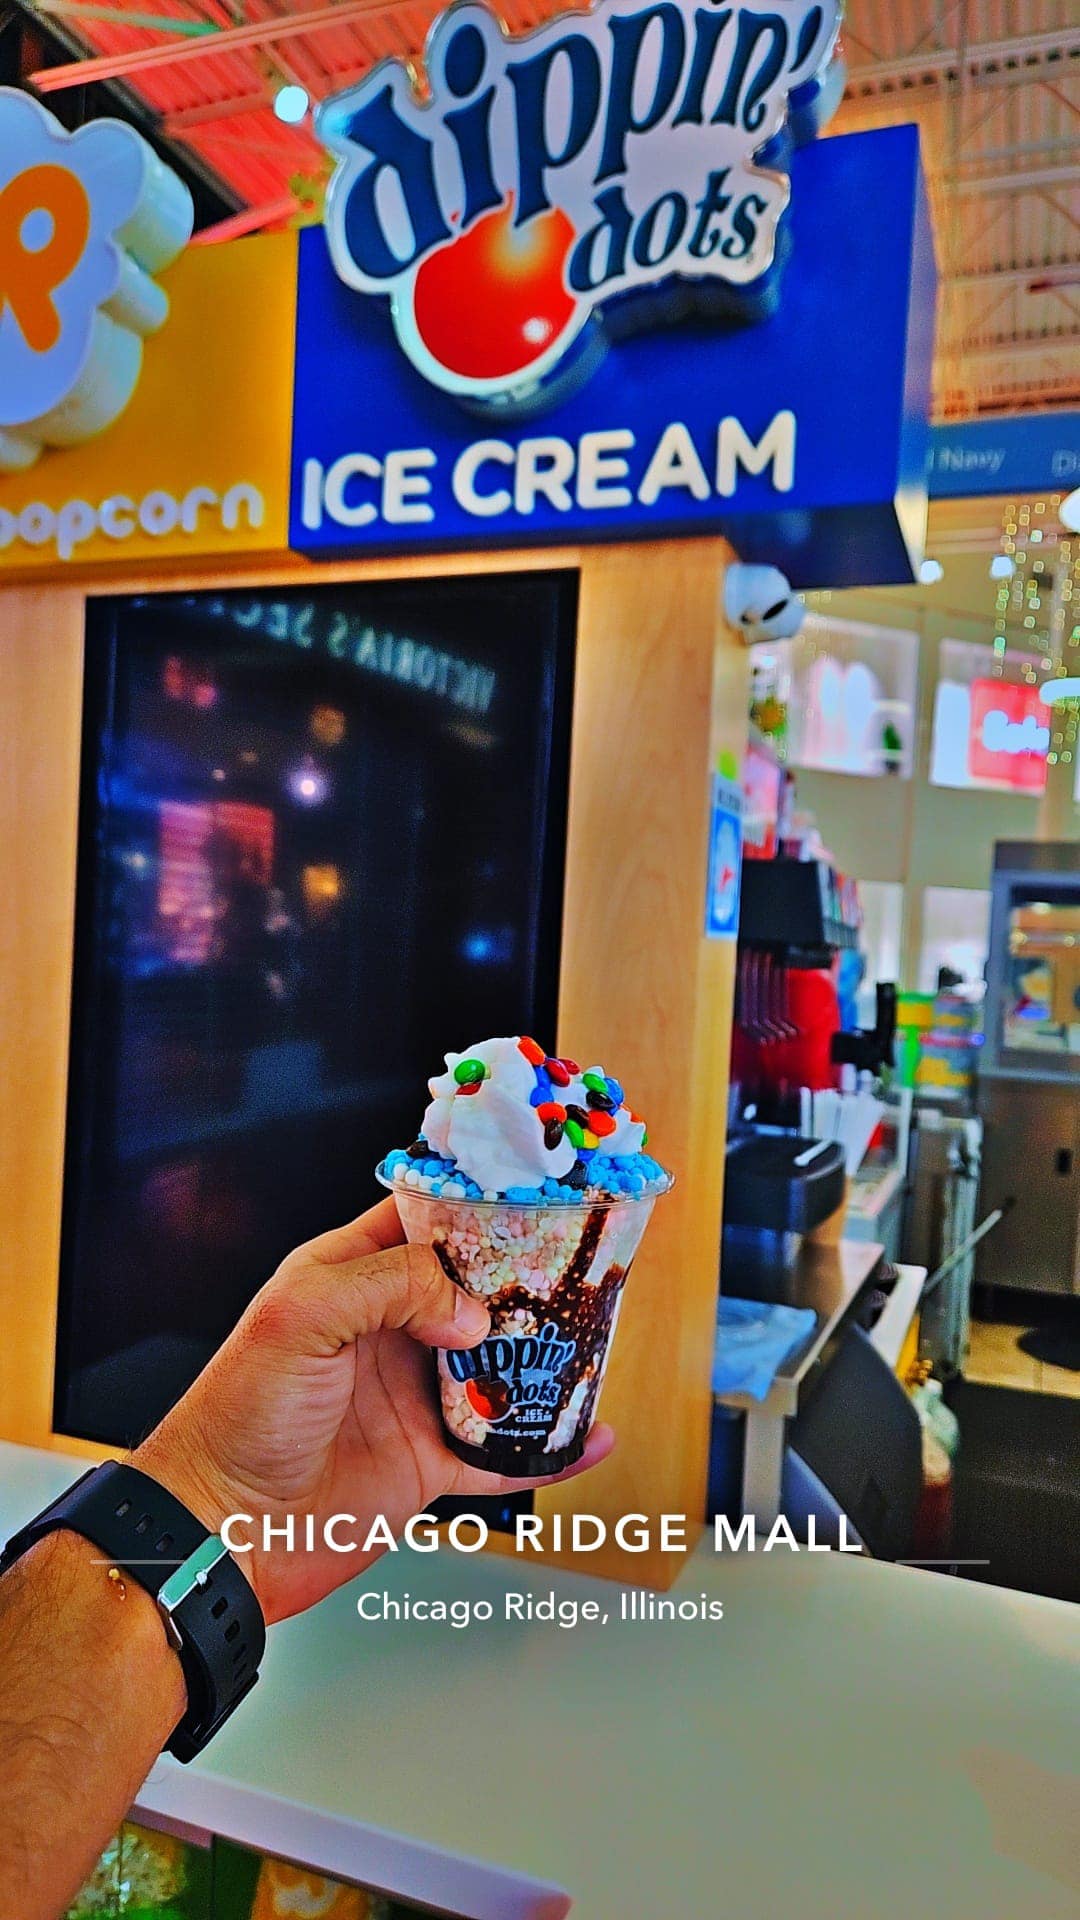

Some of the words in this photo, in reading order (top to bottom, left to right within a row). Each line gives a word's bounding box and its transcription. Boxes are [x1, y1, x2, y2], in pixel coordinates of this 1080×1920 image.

[345, 0, 822, 279] dippin'
[568, 169, 768, 293] dots
[302, 448, 437, 530] ICE
[452, 409, 797, 519] CREAM
[506, 1378, 559, 1405] dots
